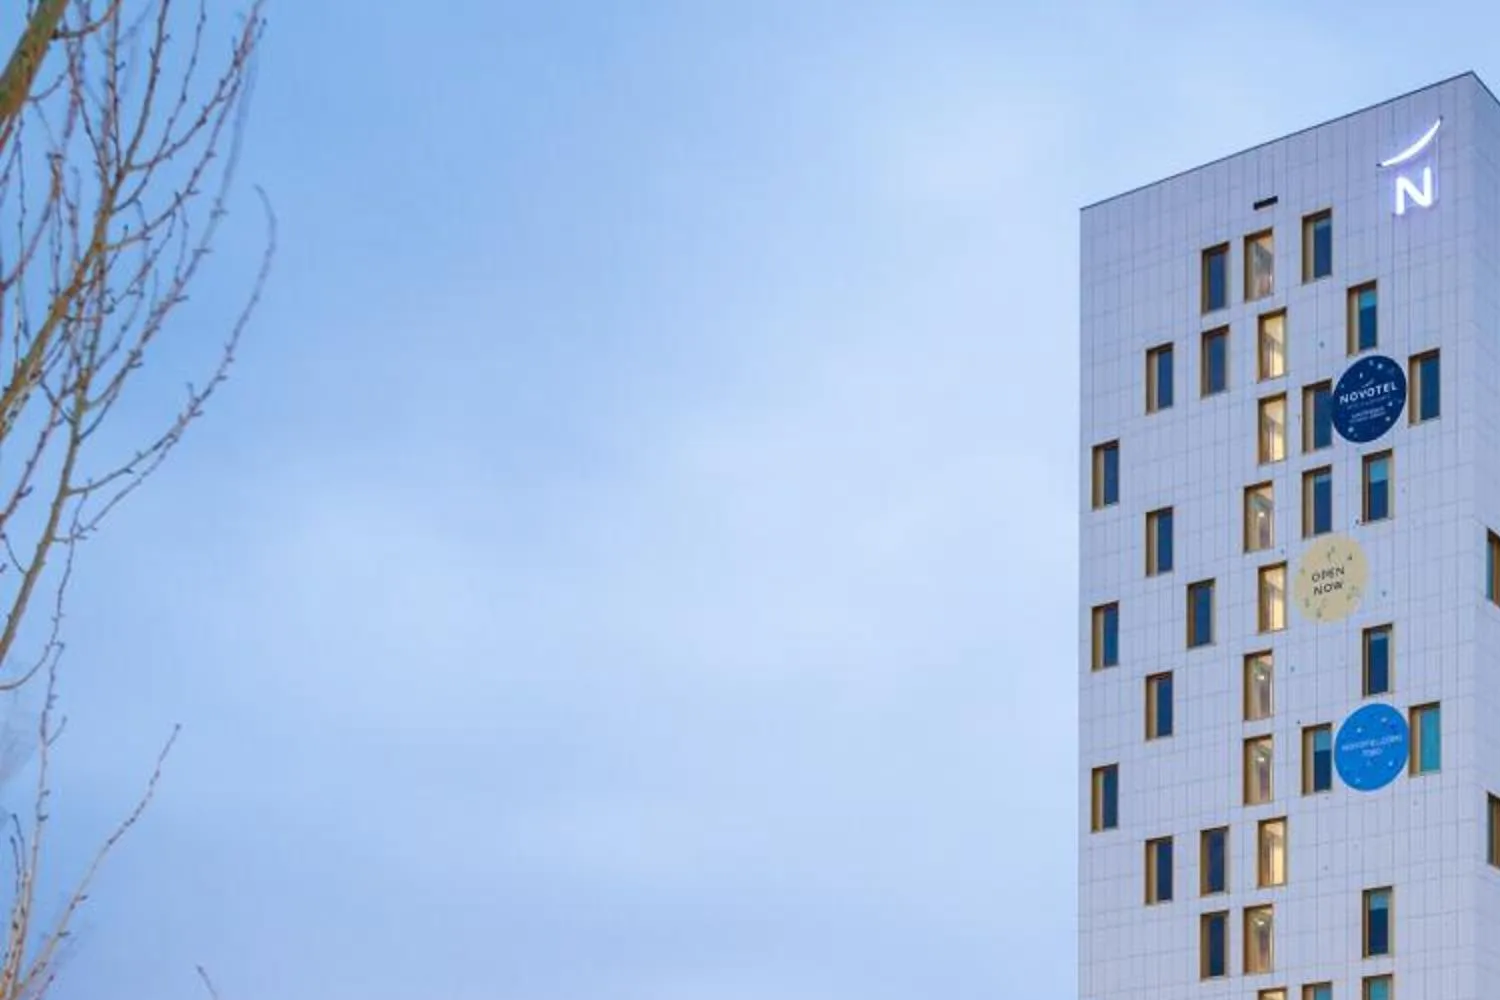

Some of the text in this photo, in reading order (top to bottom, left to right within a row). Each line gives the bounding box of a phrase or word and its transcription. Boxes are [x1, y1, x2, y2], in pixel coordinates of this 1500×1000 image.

[1396, 167, 1432, 215] N
[1339, 382, 1397, 405] NOVOTEL
[1312, 566, 1345, 582] OPEN
[1313, 581, 1343, 596] NOW
